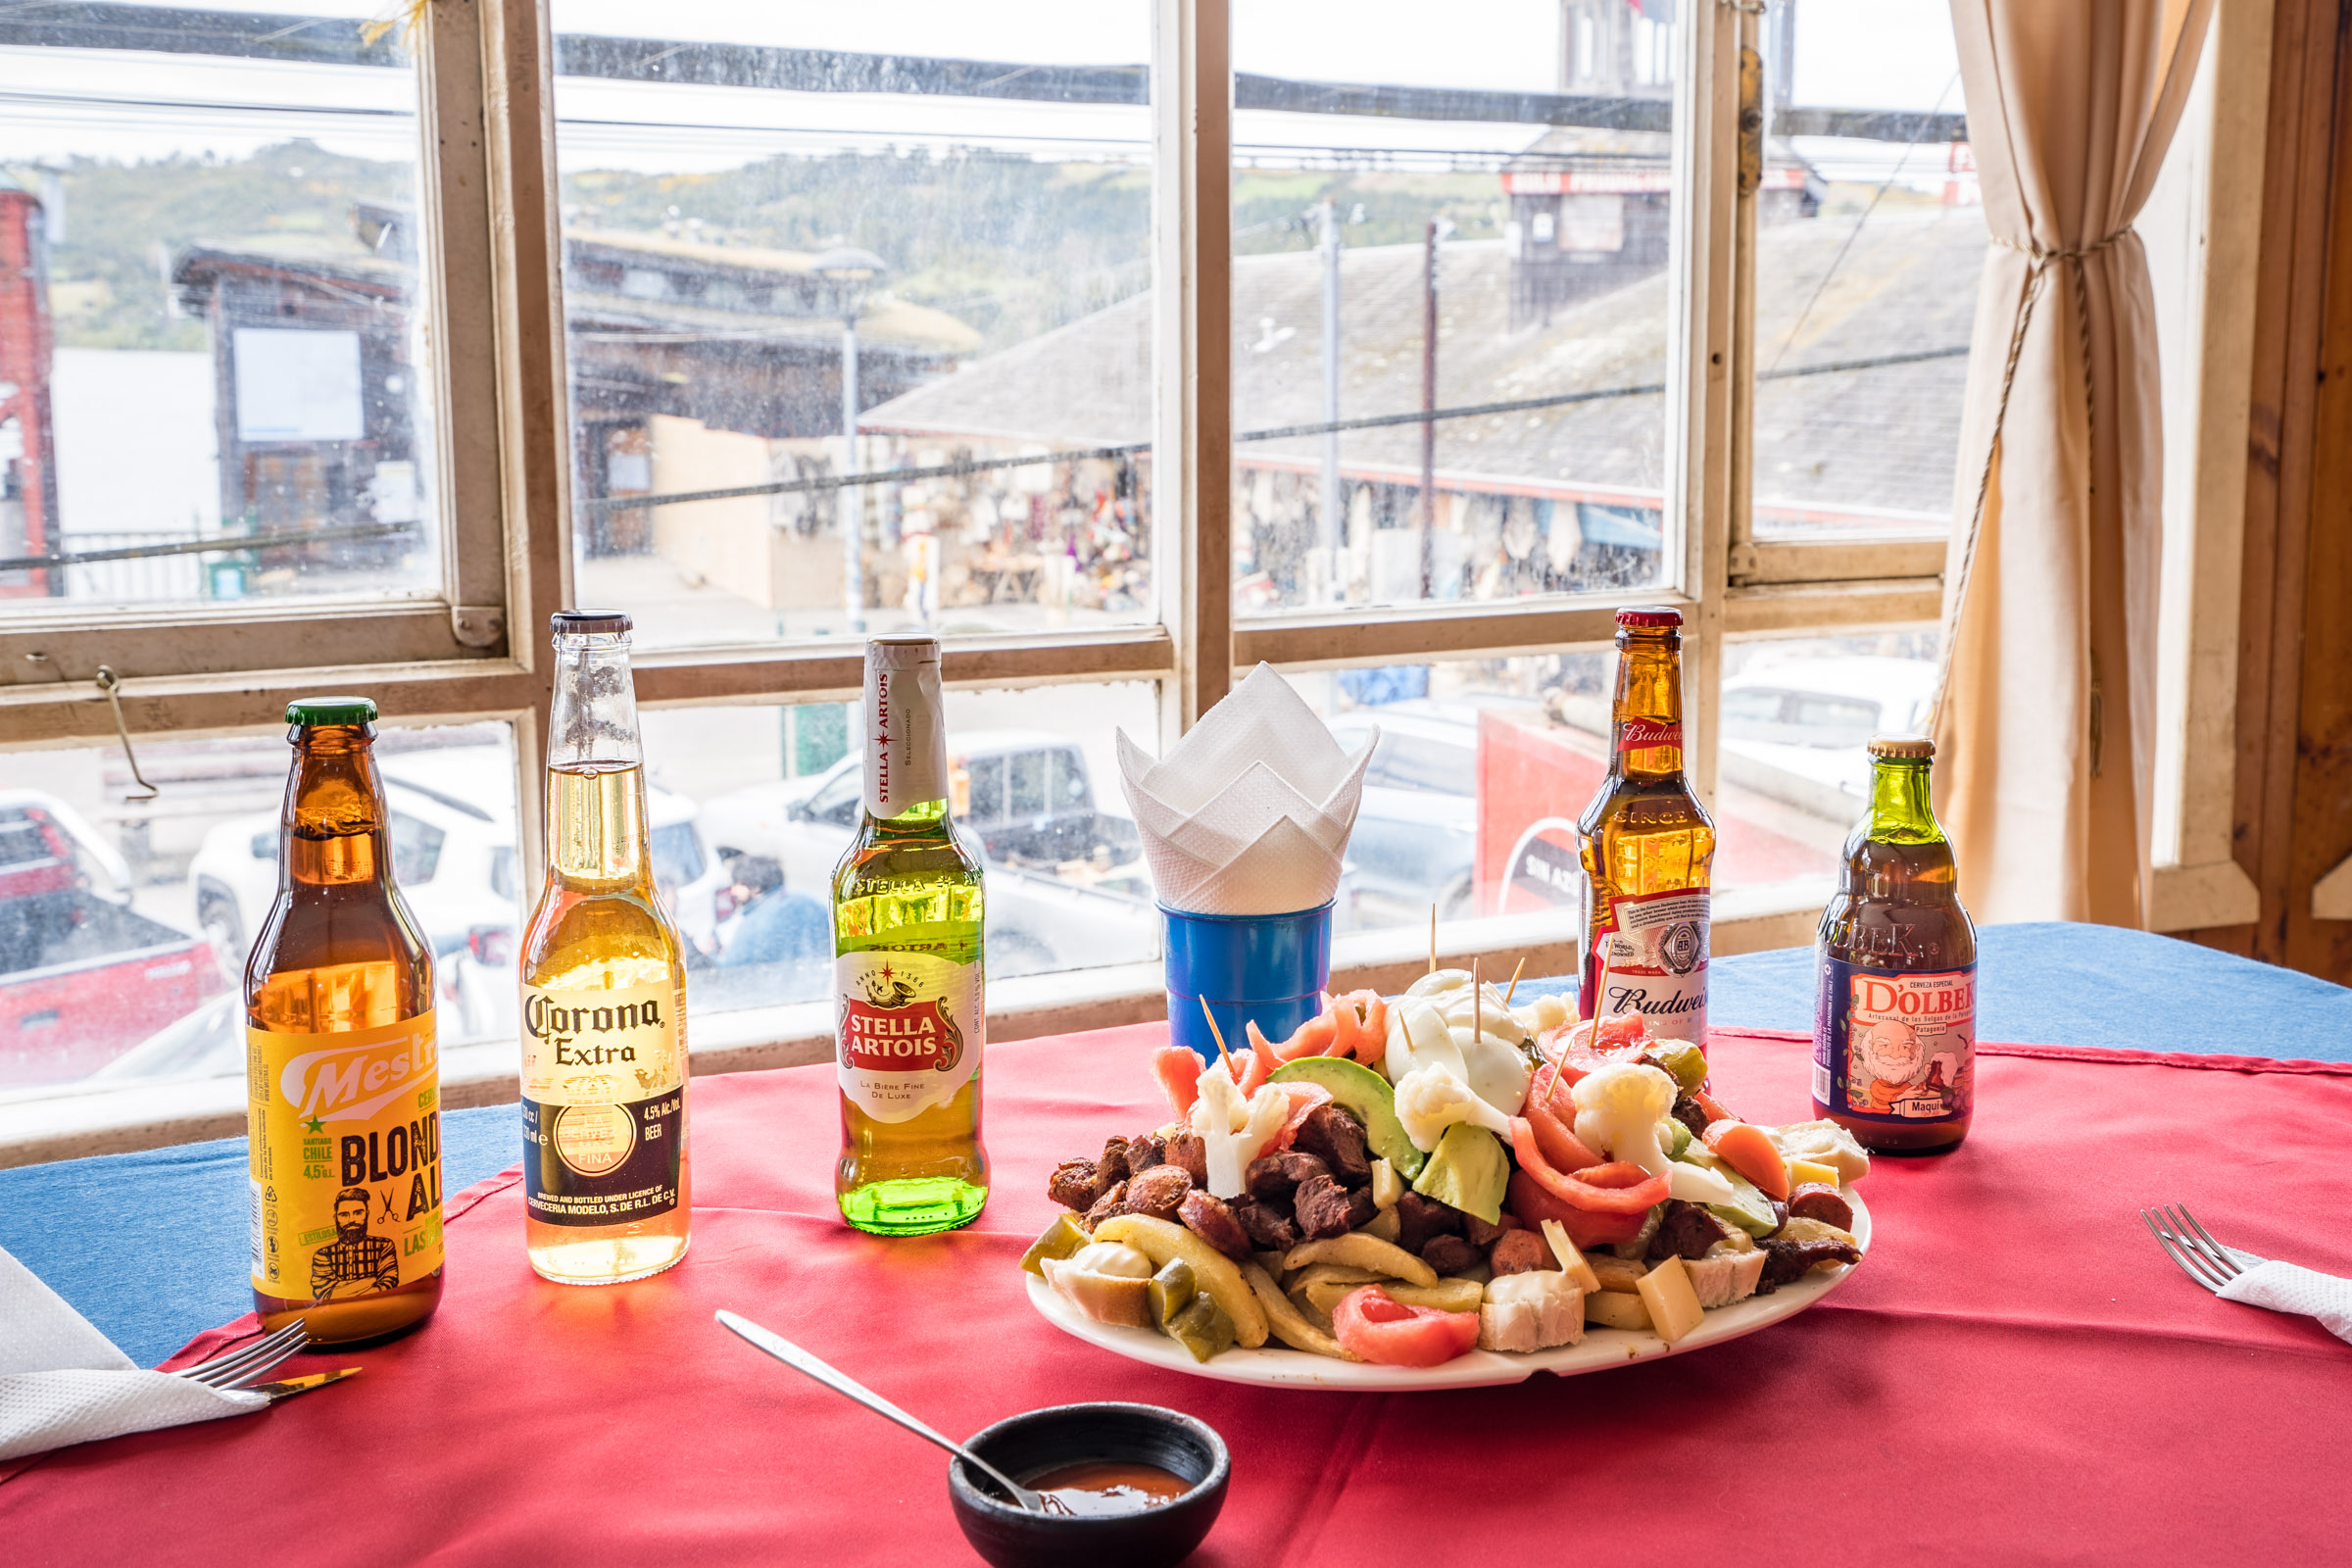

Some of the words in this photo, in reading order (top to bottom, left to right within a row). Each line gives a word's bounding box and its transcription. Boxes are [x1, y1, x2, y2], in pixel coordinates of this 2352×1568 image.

[879, 674, 888, 728] ARTOIS
[856, 878, 925, 894] STELLA
[857, 970, 876, 986] ANNO
[901, 971, 925, 988] 1366
[525, 994, 661, 1045] Corona
[851, 1013, 936, 1035] STELLA
[555, 1037, 637, 1066] Extra
[851, 1035, 937, 1056] ARTOIS
[644, 1104, 661, 1121] 4.5%
[1912, 1101, 1939, 1113] Maqui
[645, 1123, 662, 1141] BEER
[304, 1147, 332, 1160] CHILE
[579, 1152, 612, 1164] FINA
[528, 1196, 566, 1213] CERVECERIA
[568, 1204, 609, 1215] MODELO,
[619, 1201, 633, 1211] DE
[635, 1198, 651, 1209] R.L.
[652, 1194, 662, 1204] DE
[663, 1188, 676, 1200] C.V.
[537, 1192, 559, 1201] BREWED
[604, 1194, 627, 1202] UNDER
[628, 1188, 654, 1200] LICENCE
[655, 1184, 662, 1193] OF
